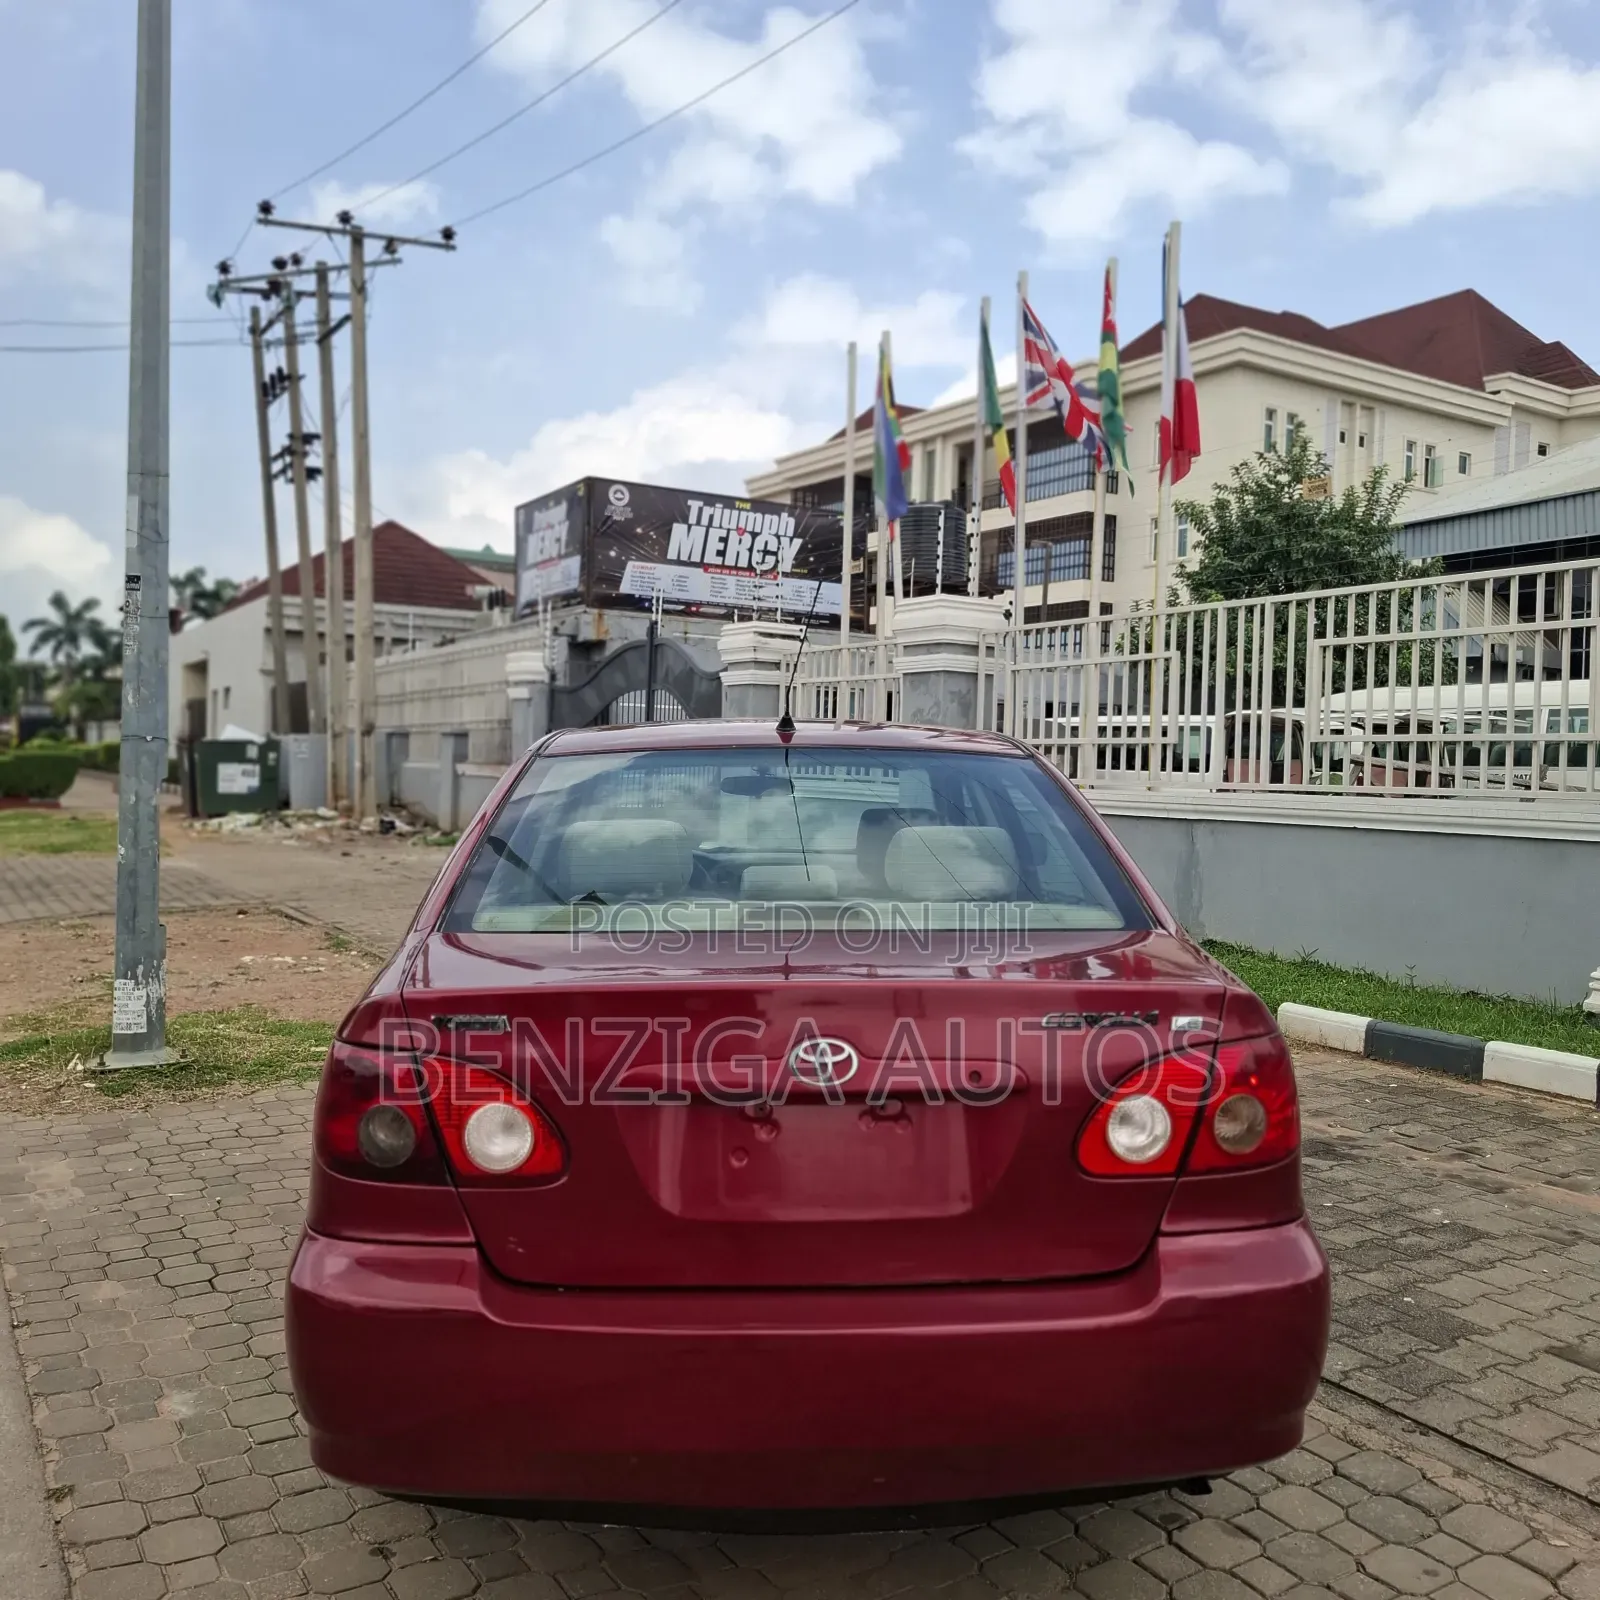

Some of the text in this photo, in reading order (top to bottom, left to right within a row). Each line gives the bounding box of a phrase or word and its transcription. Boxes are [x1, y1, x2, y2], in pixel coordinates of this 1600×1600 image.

[687, 500, 796, 537] Triumph
[735, 501, 751, 509] THE
[667, 523, 803, 573] MERCY
